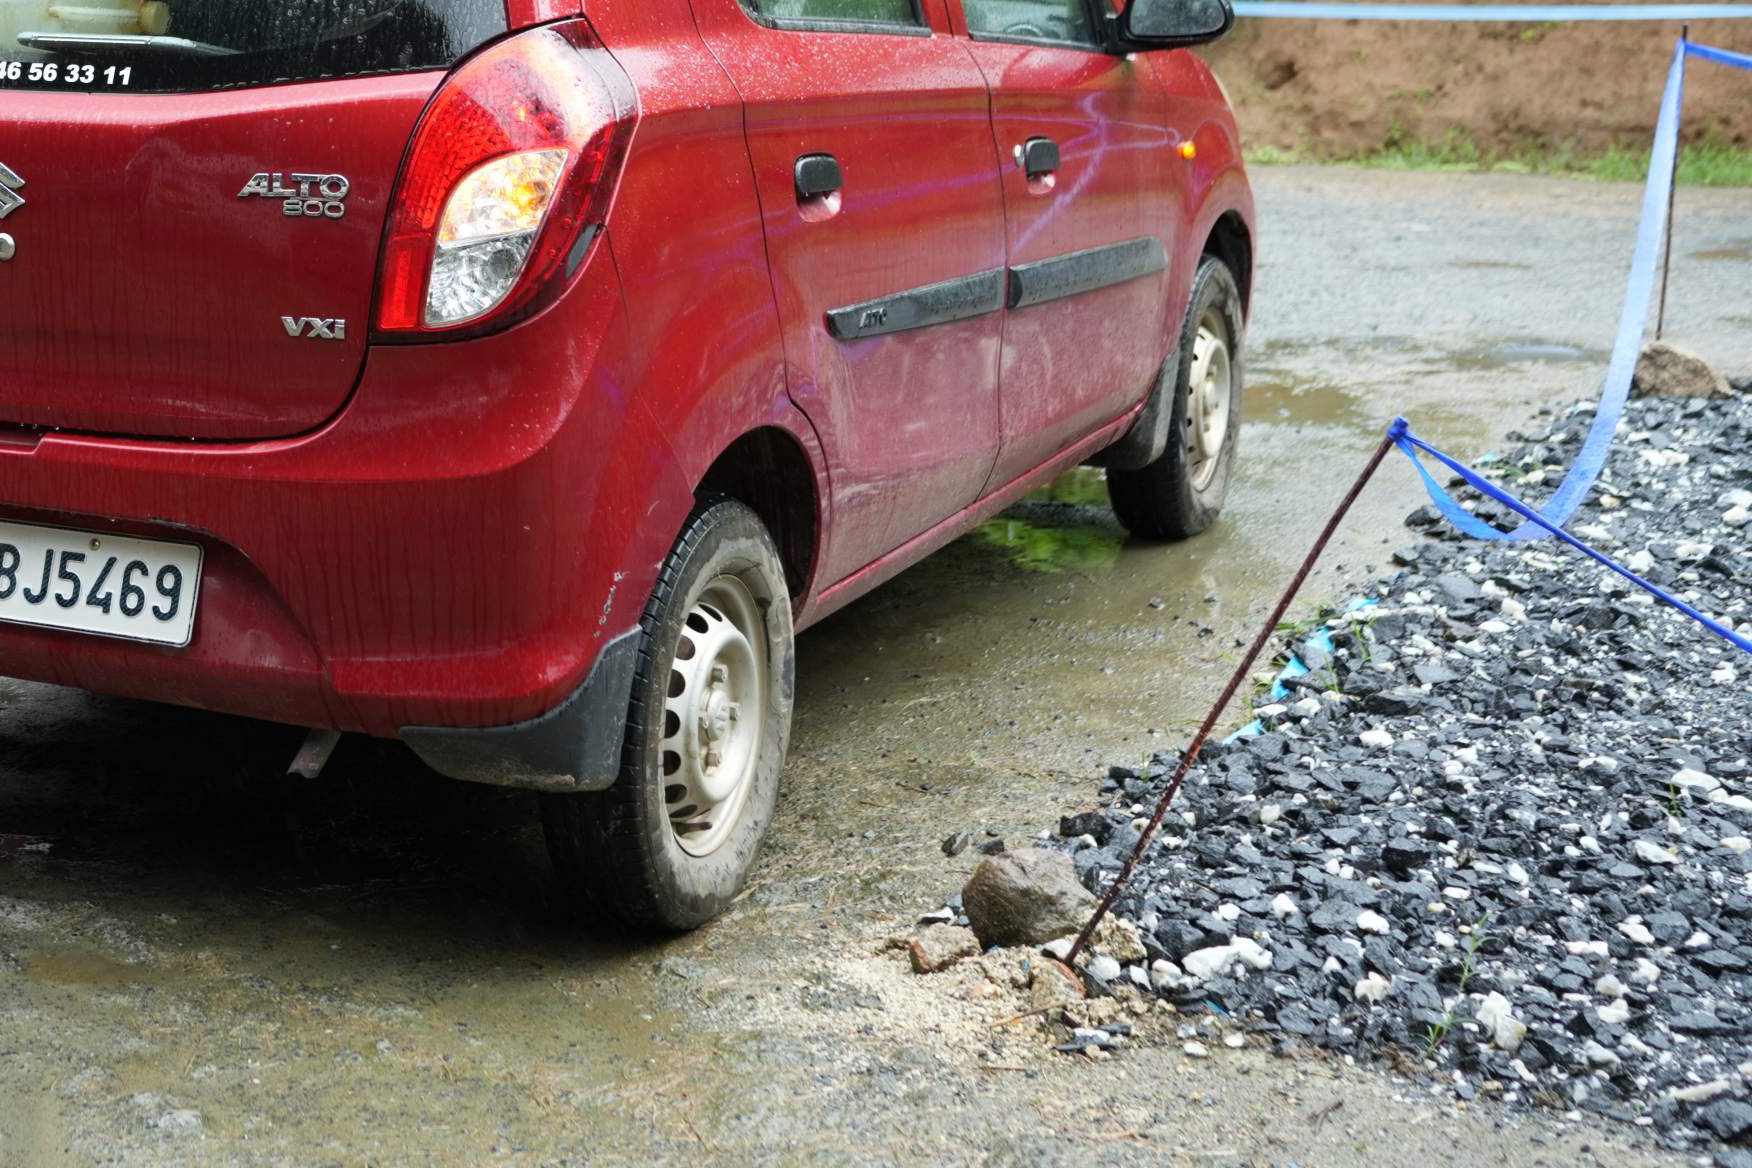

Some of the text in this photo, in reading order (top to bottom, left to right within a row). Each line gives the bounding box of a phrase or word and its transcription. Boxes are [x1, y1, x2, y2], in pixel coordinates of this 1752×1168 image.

[27, 63, 58, 82] 56
[64, 64, 95, 83] 33
[103, 66, 132, 86] 11
[237, 172, 349, 200] ALTO
[282, 199, 345, 218] 800
